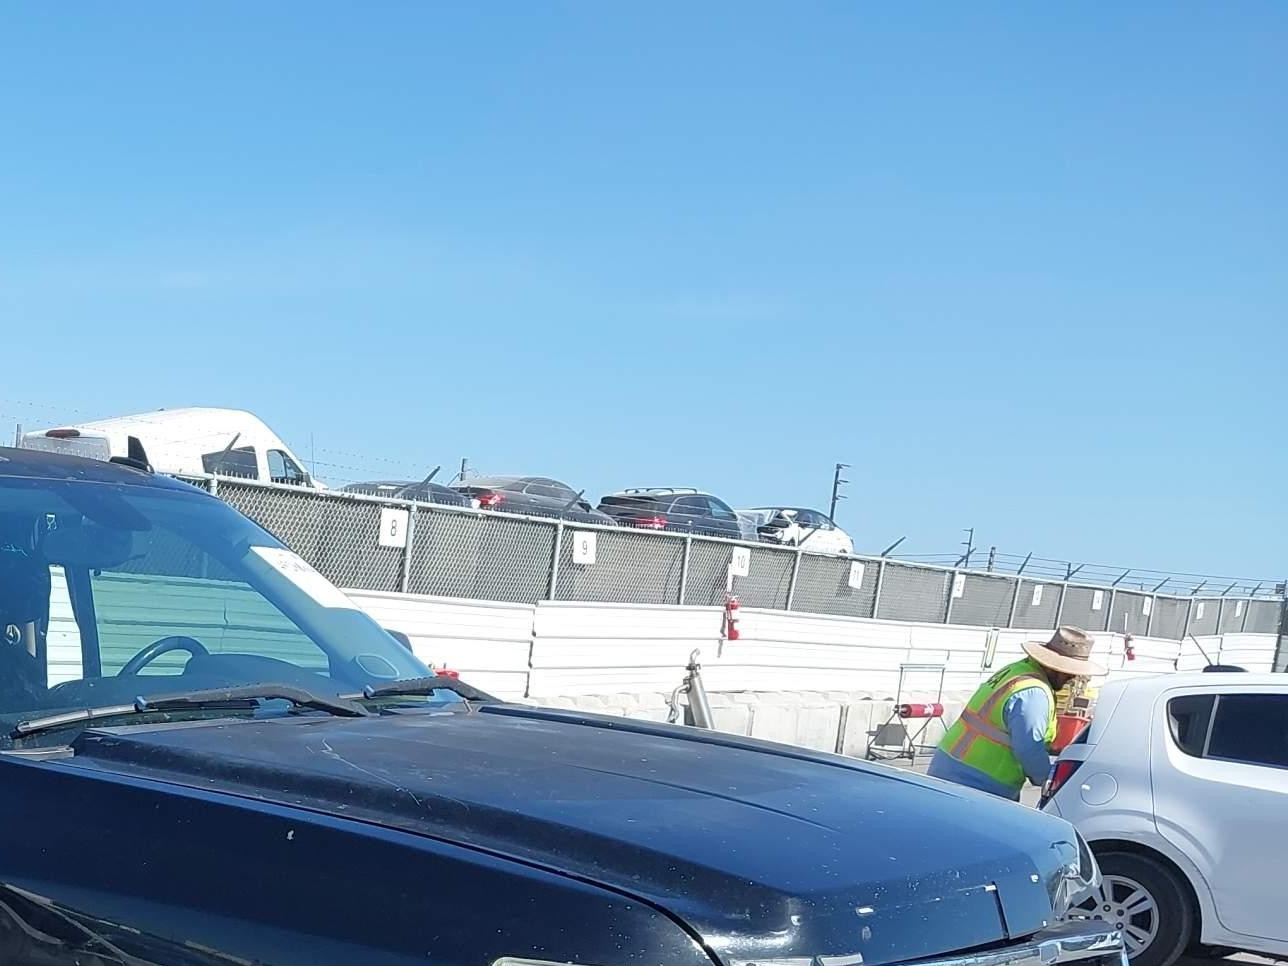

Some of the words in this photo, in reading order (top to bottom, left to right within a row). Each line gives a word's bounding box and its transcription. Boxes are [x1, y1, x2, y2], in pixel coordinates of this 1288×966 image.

[390, 519, 398, 537] 8
[582, 540, 588, 555] 9
[737, 555, 746, 569] 10
